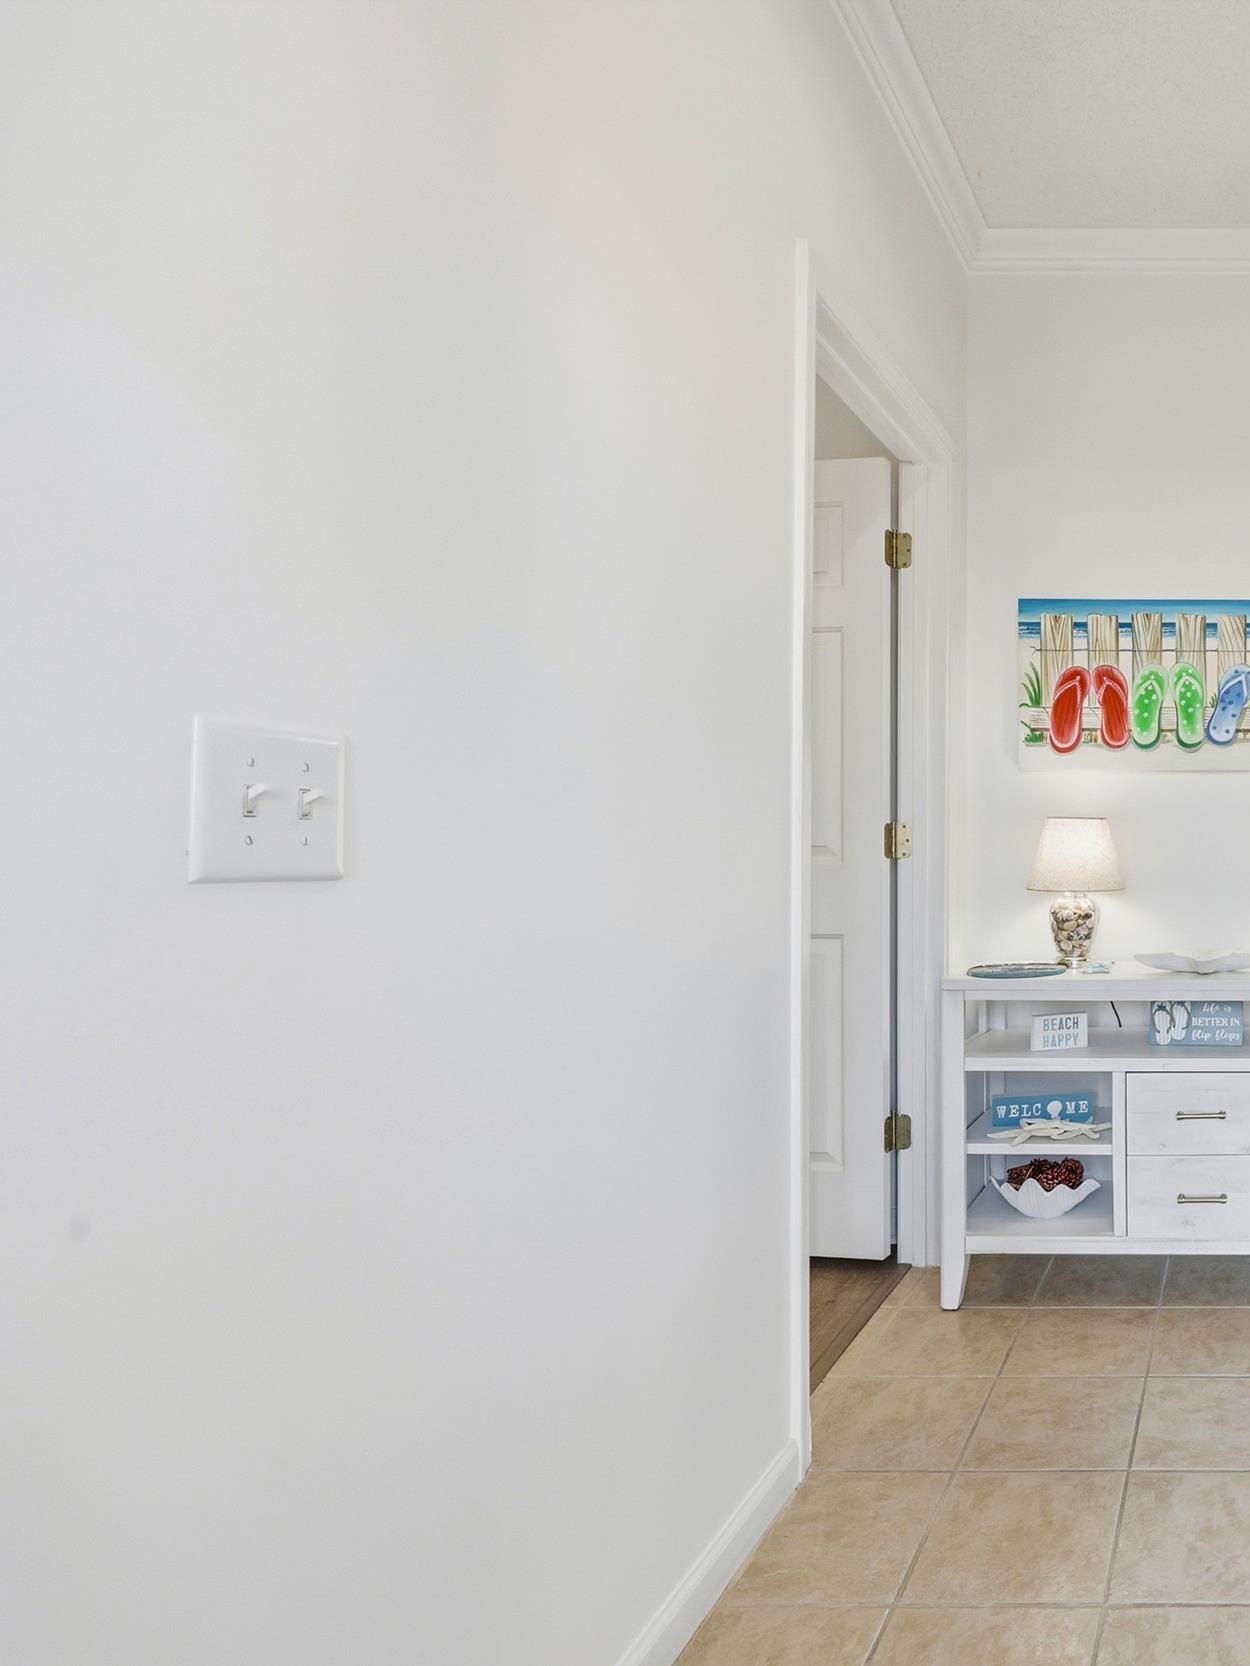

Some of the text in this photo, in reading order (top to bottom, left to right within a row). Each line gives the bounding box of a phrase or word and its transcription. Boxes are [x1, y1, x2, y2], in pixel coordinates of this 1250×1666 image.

[1202, 1002, 1232, 1013] Life is
[1043, 1016, 1079, 1031] BEACH
[1191, 1017, 1240, 1026] BETTER IN
[1043, 1032, 1079, 1048] HAPPY
[1192, 1029, 1240, 1041] flip flops
[996, 1100, 1089, 1119] WELCME
